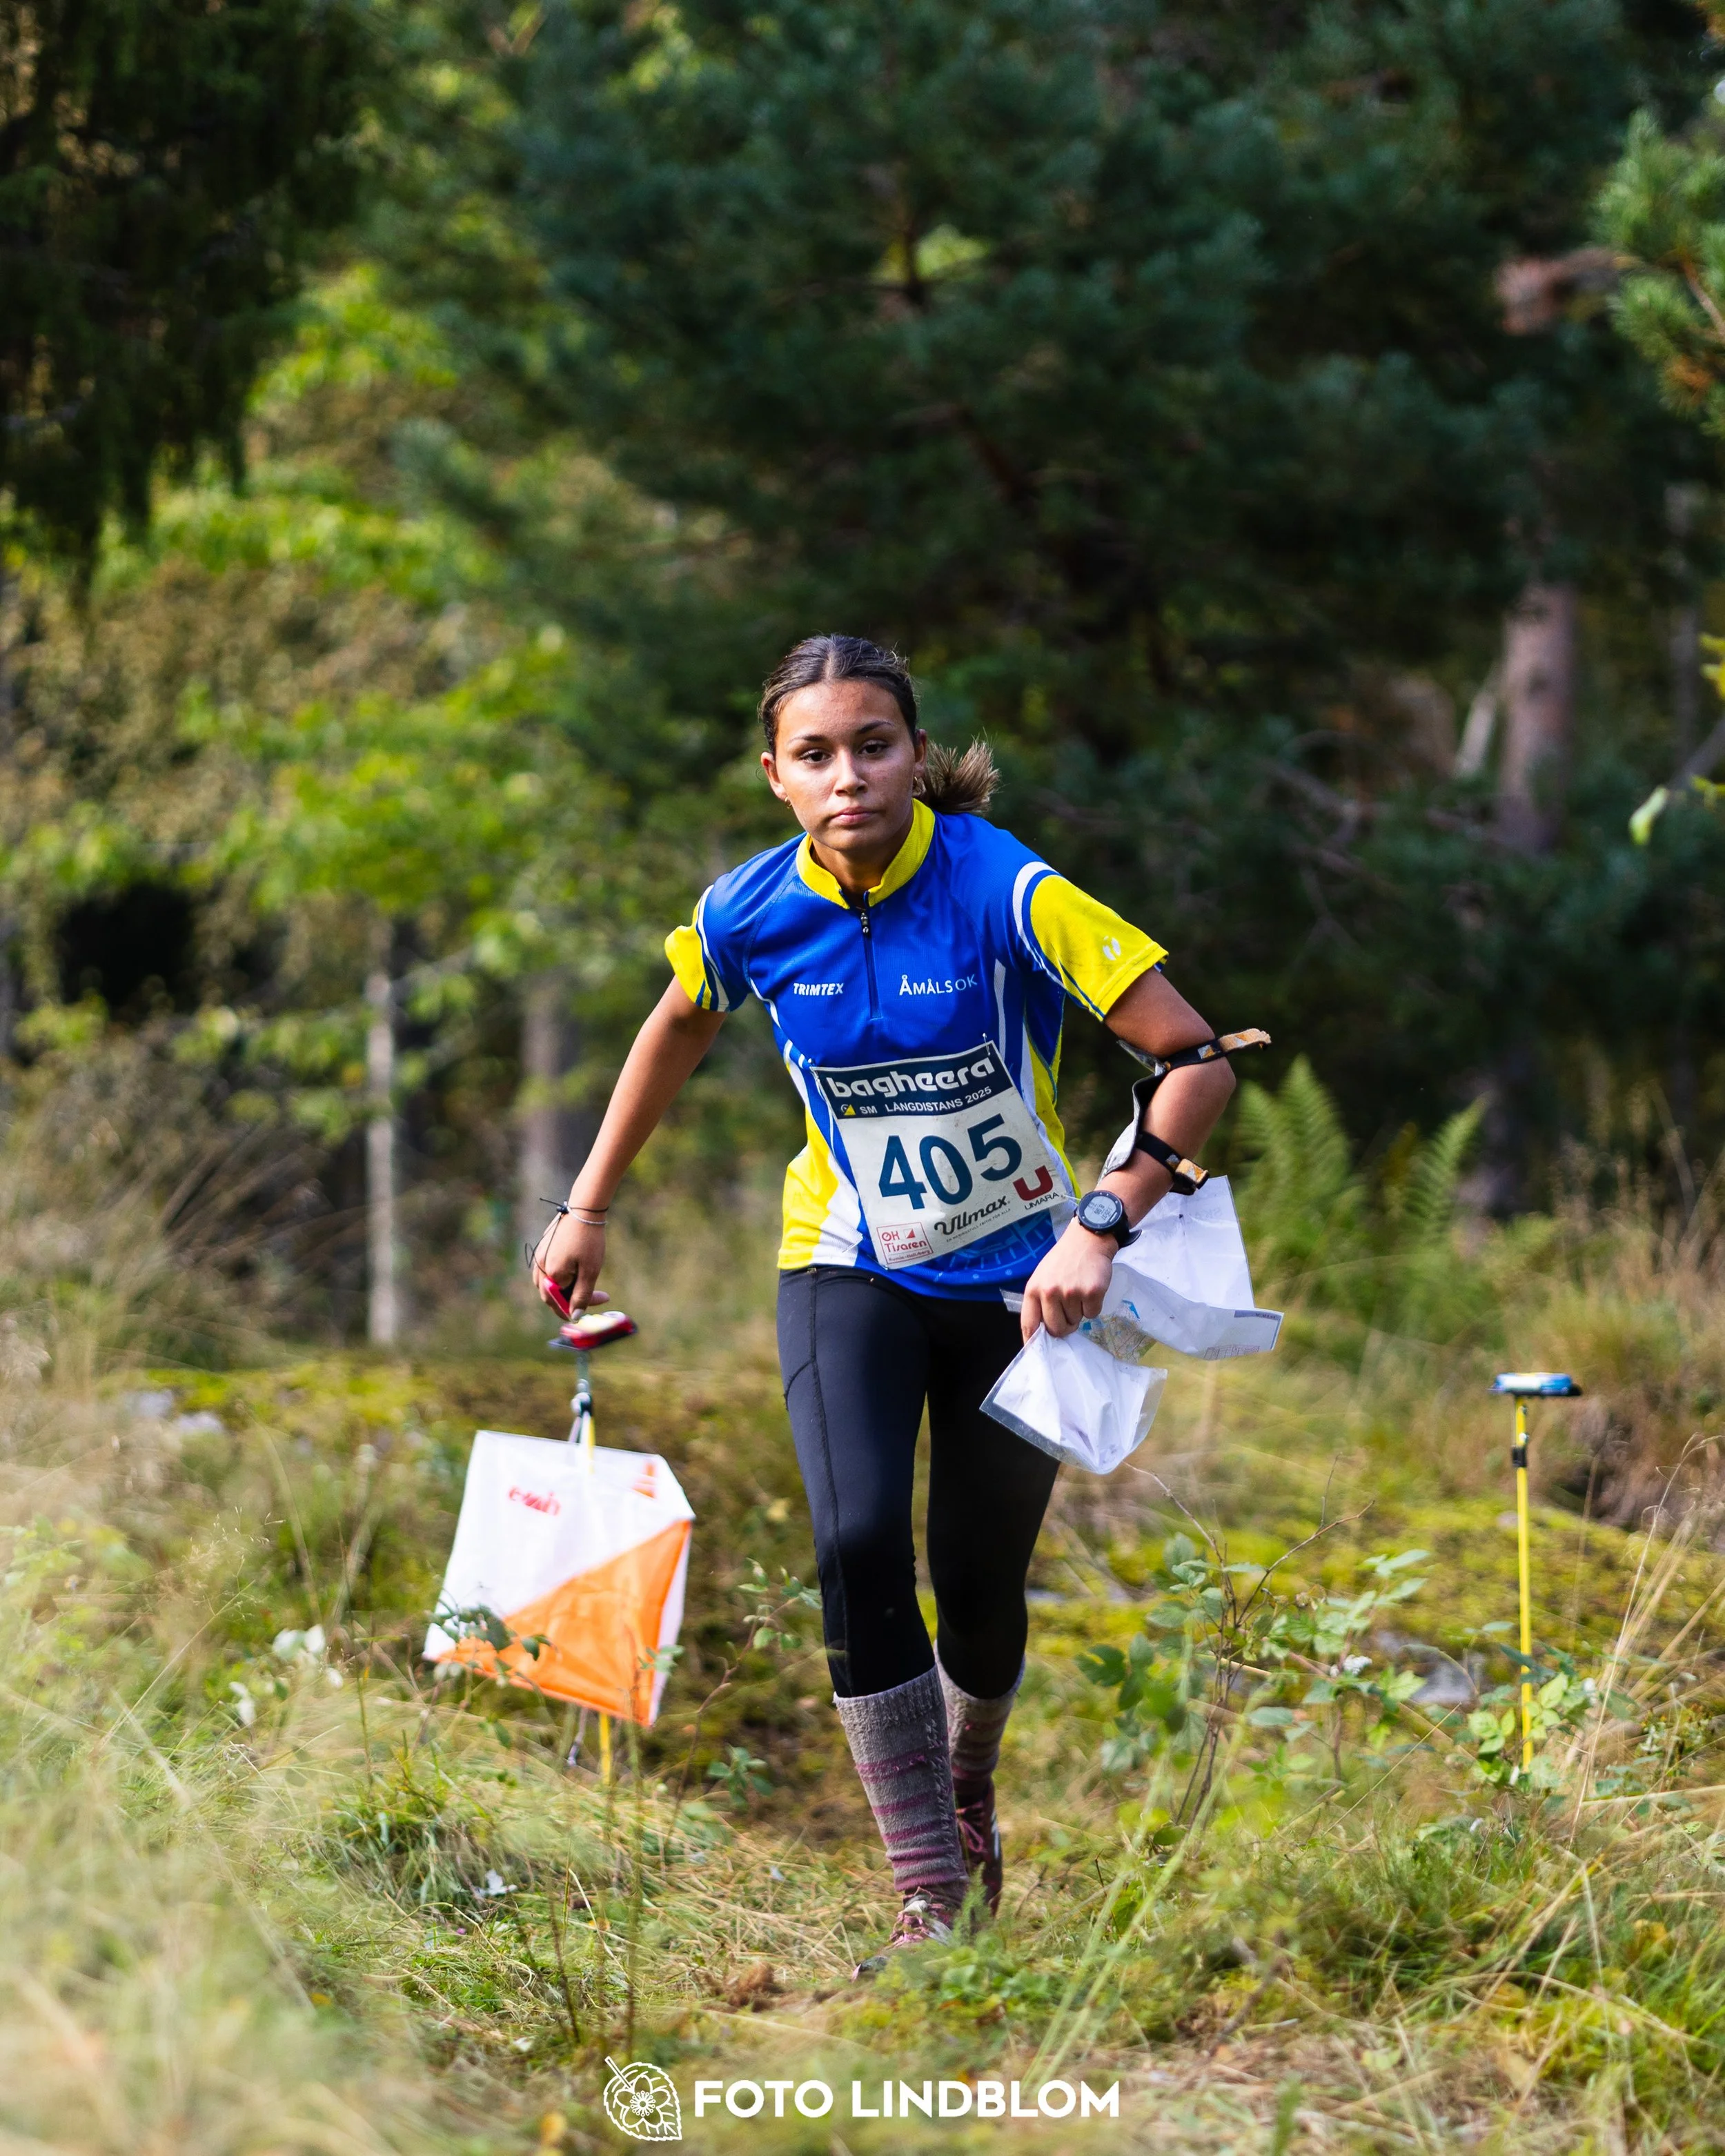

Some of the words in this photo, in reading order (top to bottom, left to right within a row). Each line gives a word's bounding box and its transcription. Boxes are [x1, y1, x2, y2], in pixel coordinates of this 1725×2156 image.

[792, 982, 843, 996] TRIMTEX
[827, 1058, 995, 1098] bagheera
[860, 1105, 878, 1114] SM
[885, 1098, 963, 1112] LÅNGDISTANS
[965, 1087, 992, 1103] 2025
[878, 1114, 1022, 1210] 405
[1024, 1192, 1059, 1210] UMARA
[934, 1196, 1007, 1236] Ullmax
[884, 1240, 927, 1253] Tisaren
